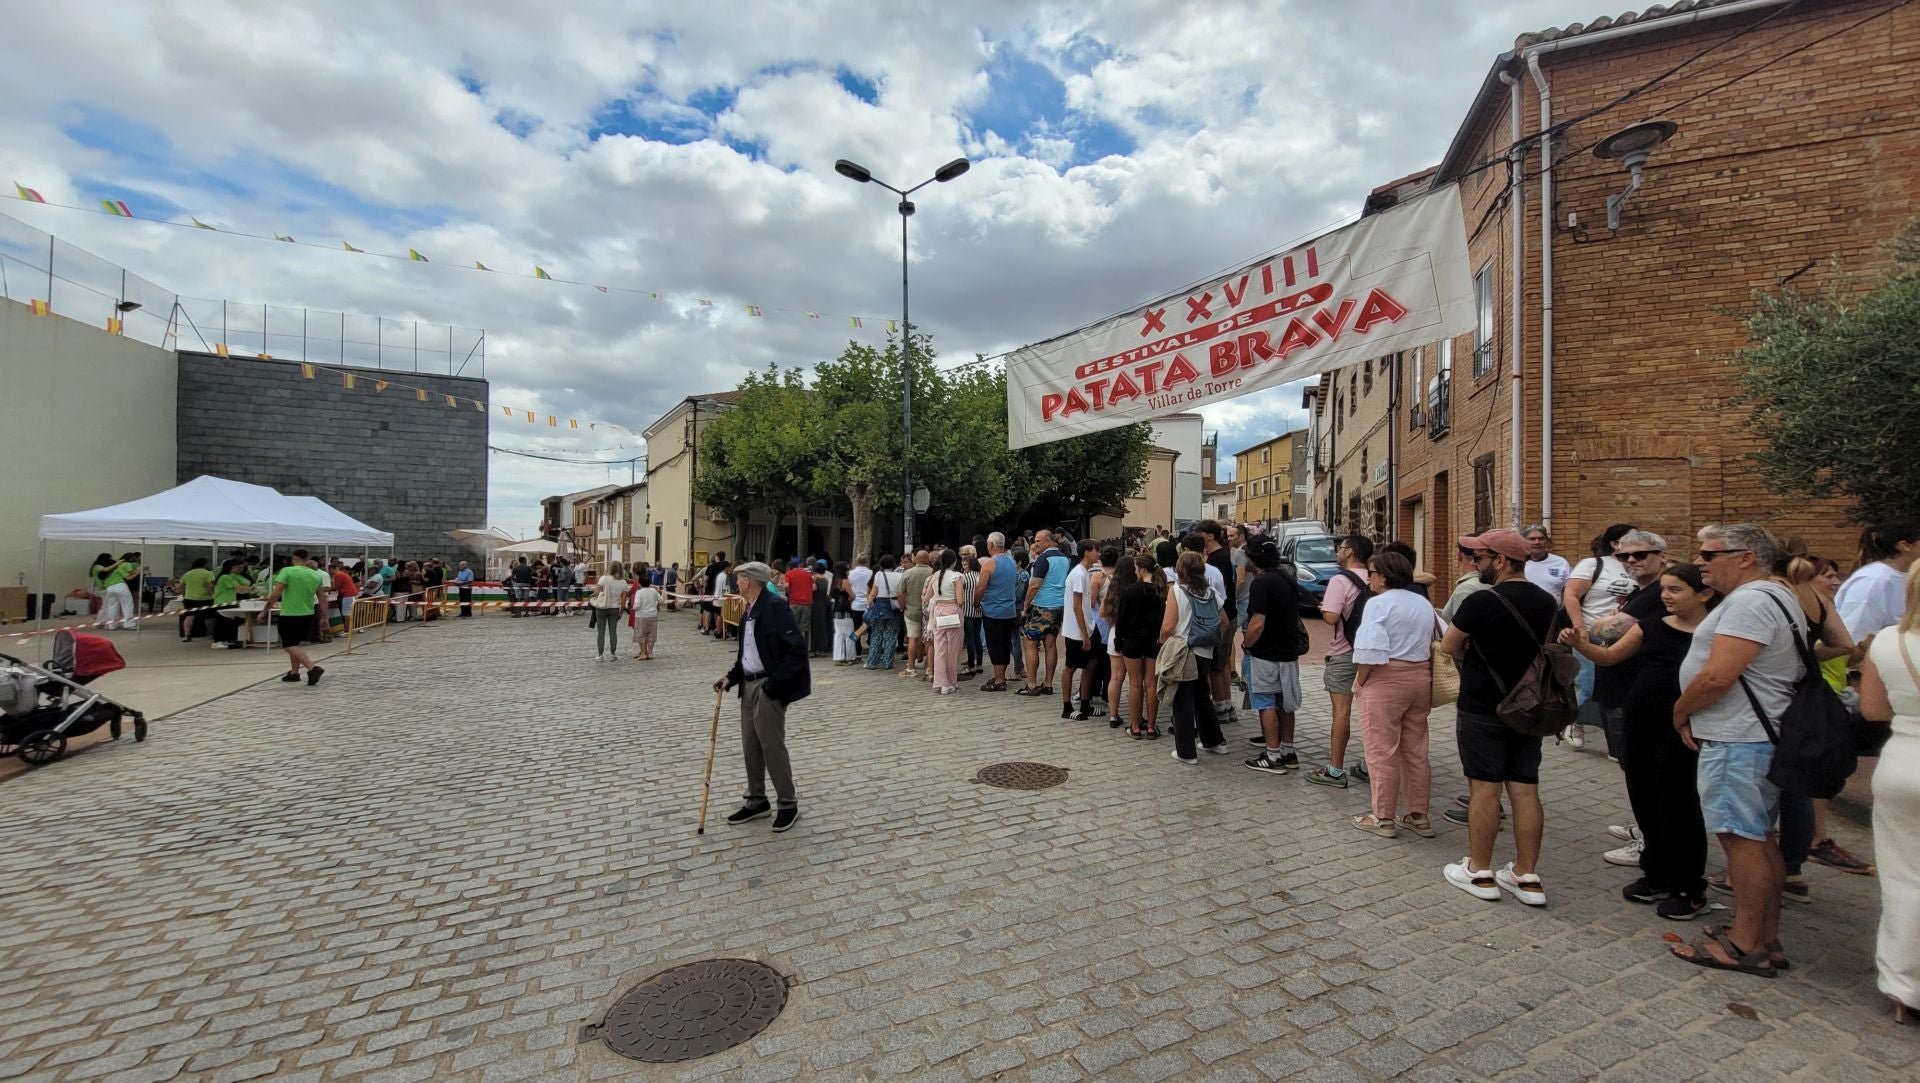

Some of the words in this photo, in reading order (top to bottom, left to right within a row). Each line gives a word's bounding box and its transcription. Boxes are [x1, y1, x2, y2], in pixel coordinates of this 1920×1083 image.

[1041, 353, 1199, 422] PATATA
[1209, 288, 1407, 377] BRAVA
[1084, 333, 1198, 374] FESTIVAL
[1218, 313, 1251, 331] DE
[1274, 293, 1315, 313] LA
[1148, 393, 1183, 410] Villar
[1187, 387, 1203, 402] de
[1206, 377, 1242, 396] Torre
